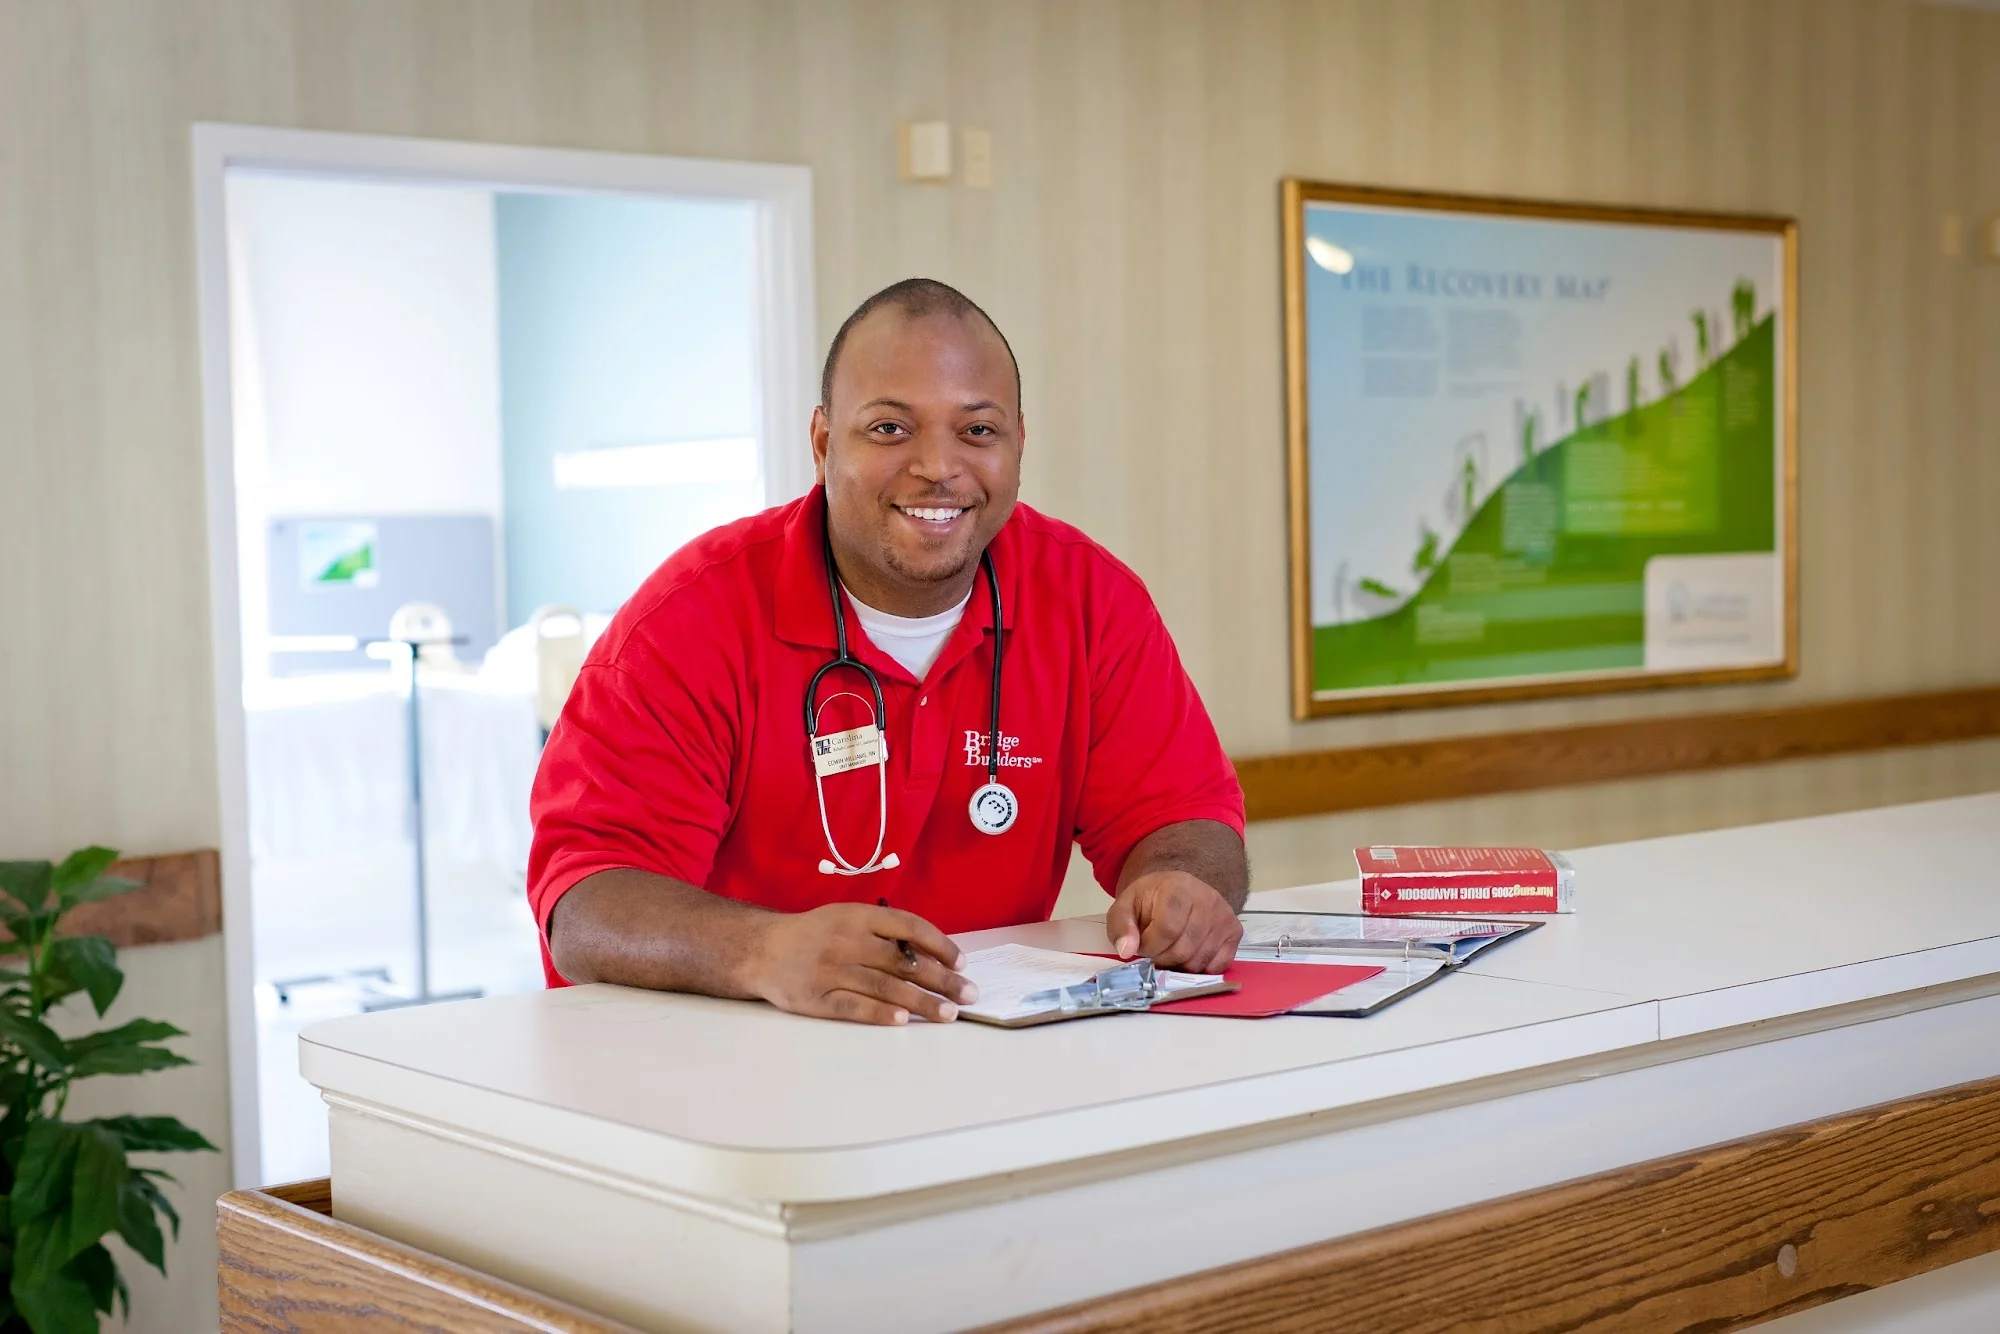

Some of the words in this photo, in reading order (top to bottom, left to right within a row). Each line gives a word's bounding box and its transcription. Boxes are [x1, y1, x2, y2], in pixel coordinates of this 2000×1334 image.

[831, 735, 862, 745] Carolina
[828, 758, 844, 767] EDWIN
[964, 746, 1032, 768] Bulders
[1398, 888, 1459, 901] HANDBOOK
[1459, 887, 1491, 900] DRUG
